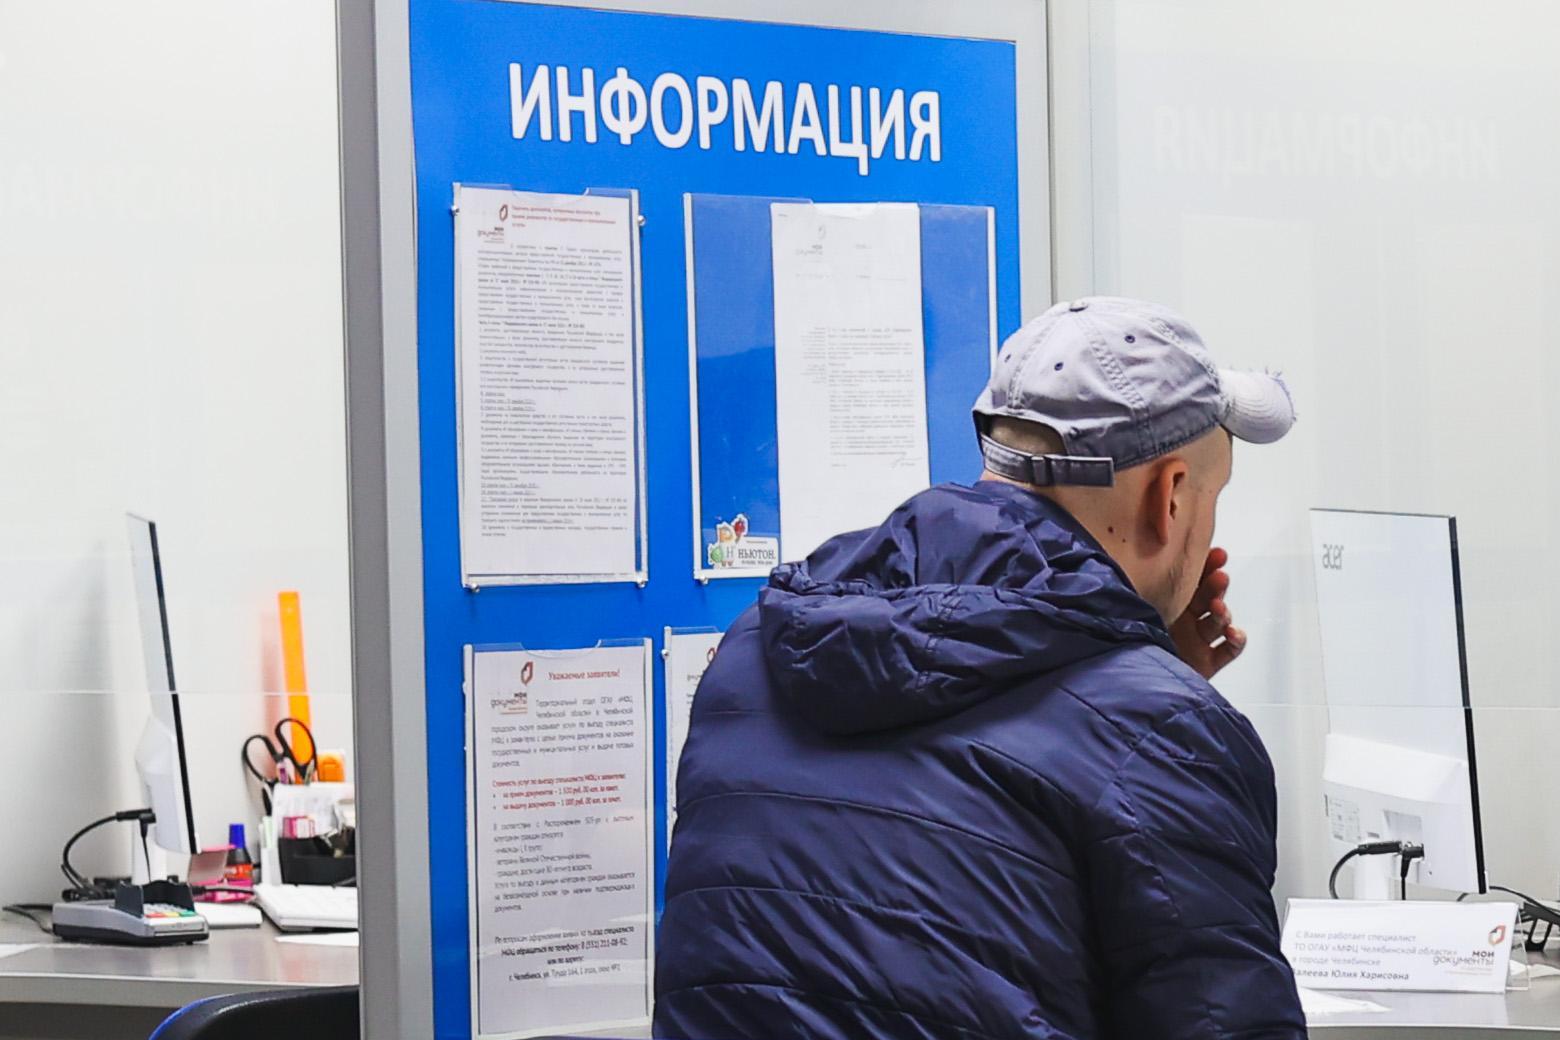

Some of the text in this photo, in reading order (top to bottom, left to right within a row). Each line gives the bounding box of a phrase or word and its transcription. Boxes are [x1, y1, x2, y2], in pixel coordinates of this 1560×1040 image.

[508, 62, 943, 176] ИНФОРМАЦИЯ
[1322, 543, 1345, 570] acer
[1304, 931, 1327, 940] Вами
[1327, 932, 1367, 941] работает
[1368, 933, 1417, 943] специалист
[1295, 943, 1458, 956] ТО ОГАУ «МФЦ Челябинской области»
[1330, 958, 1381, 966] Челябинске
[1432, 956, 1495, 966] документы
[1331, 970, 1358, 978] Юлия
[1360, 970, 1409, 981] Харисовна
